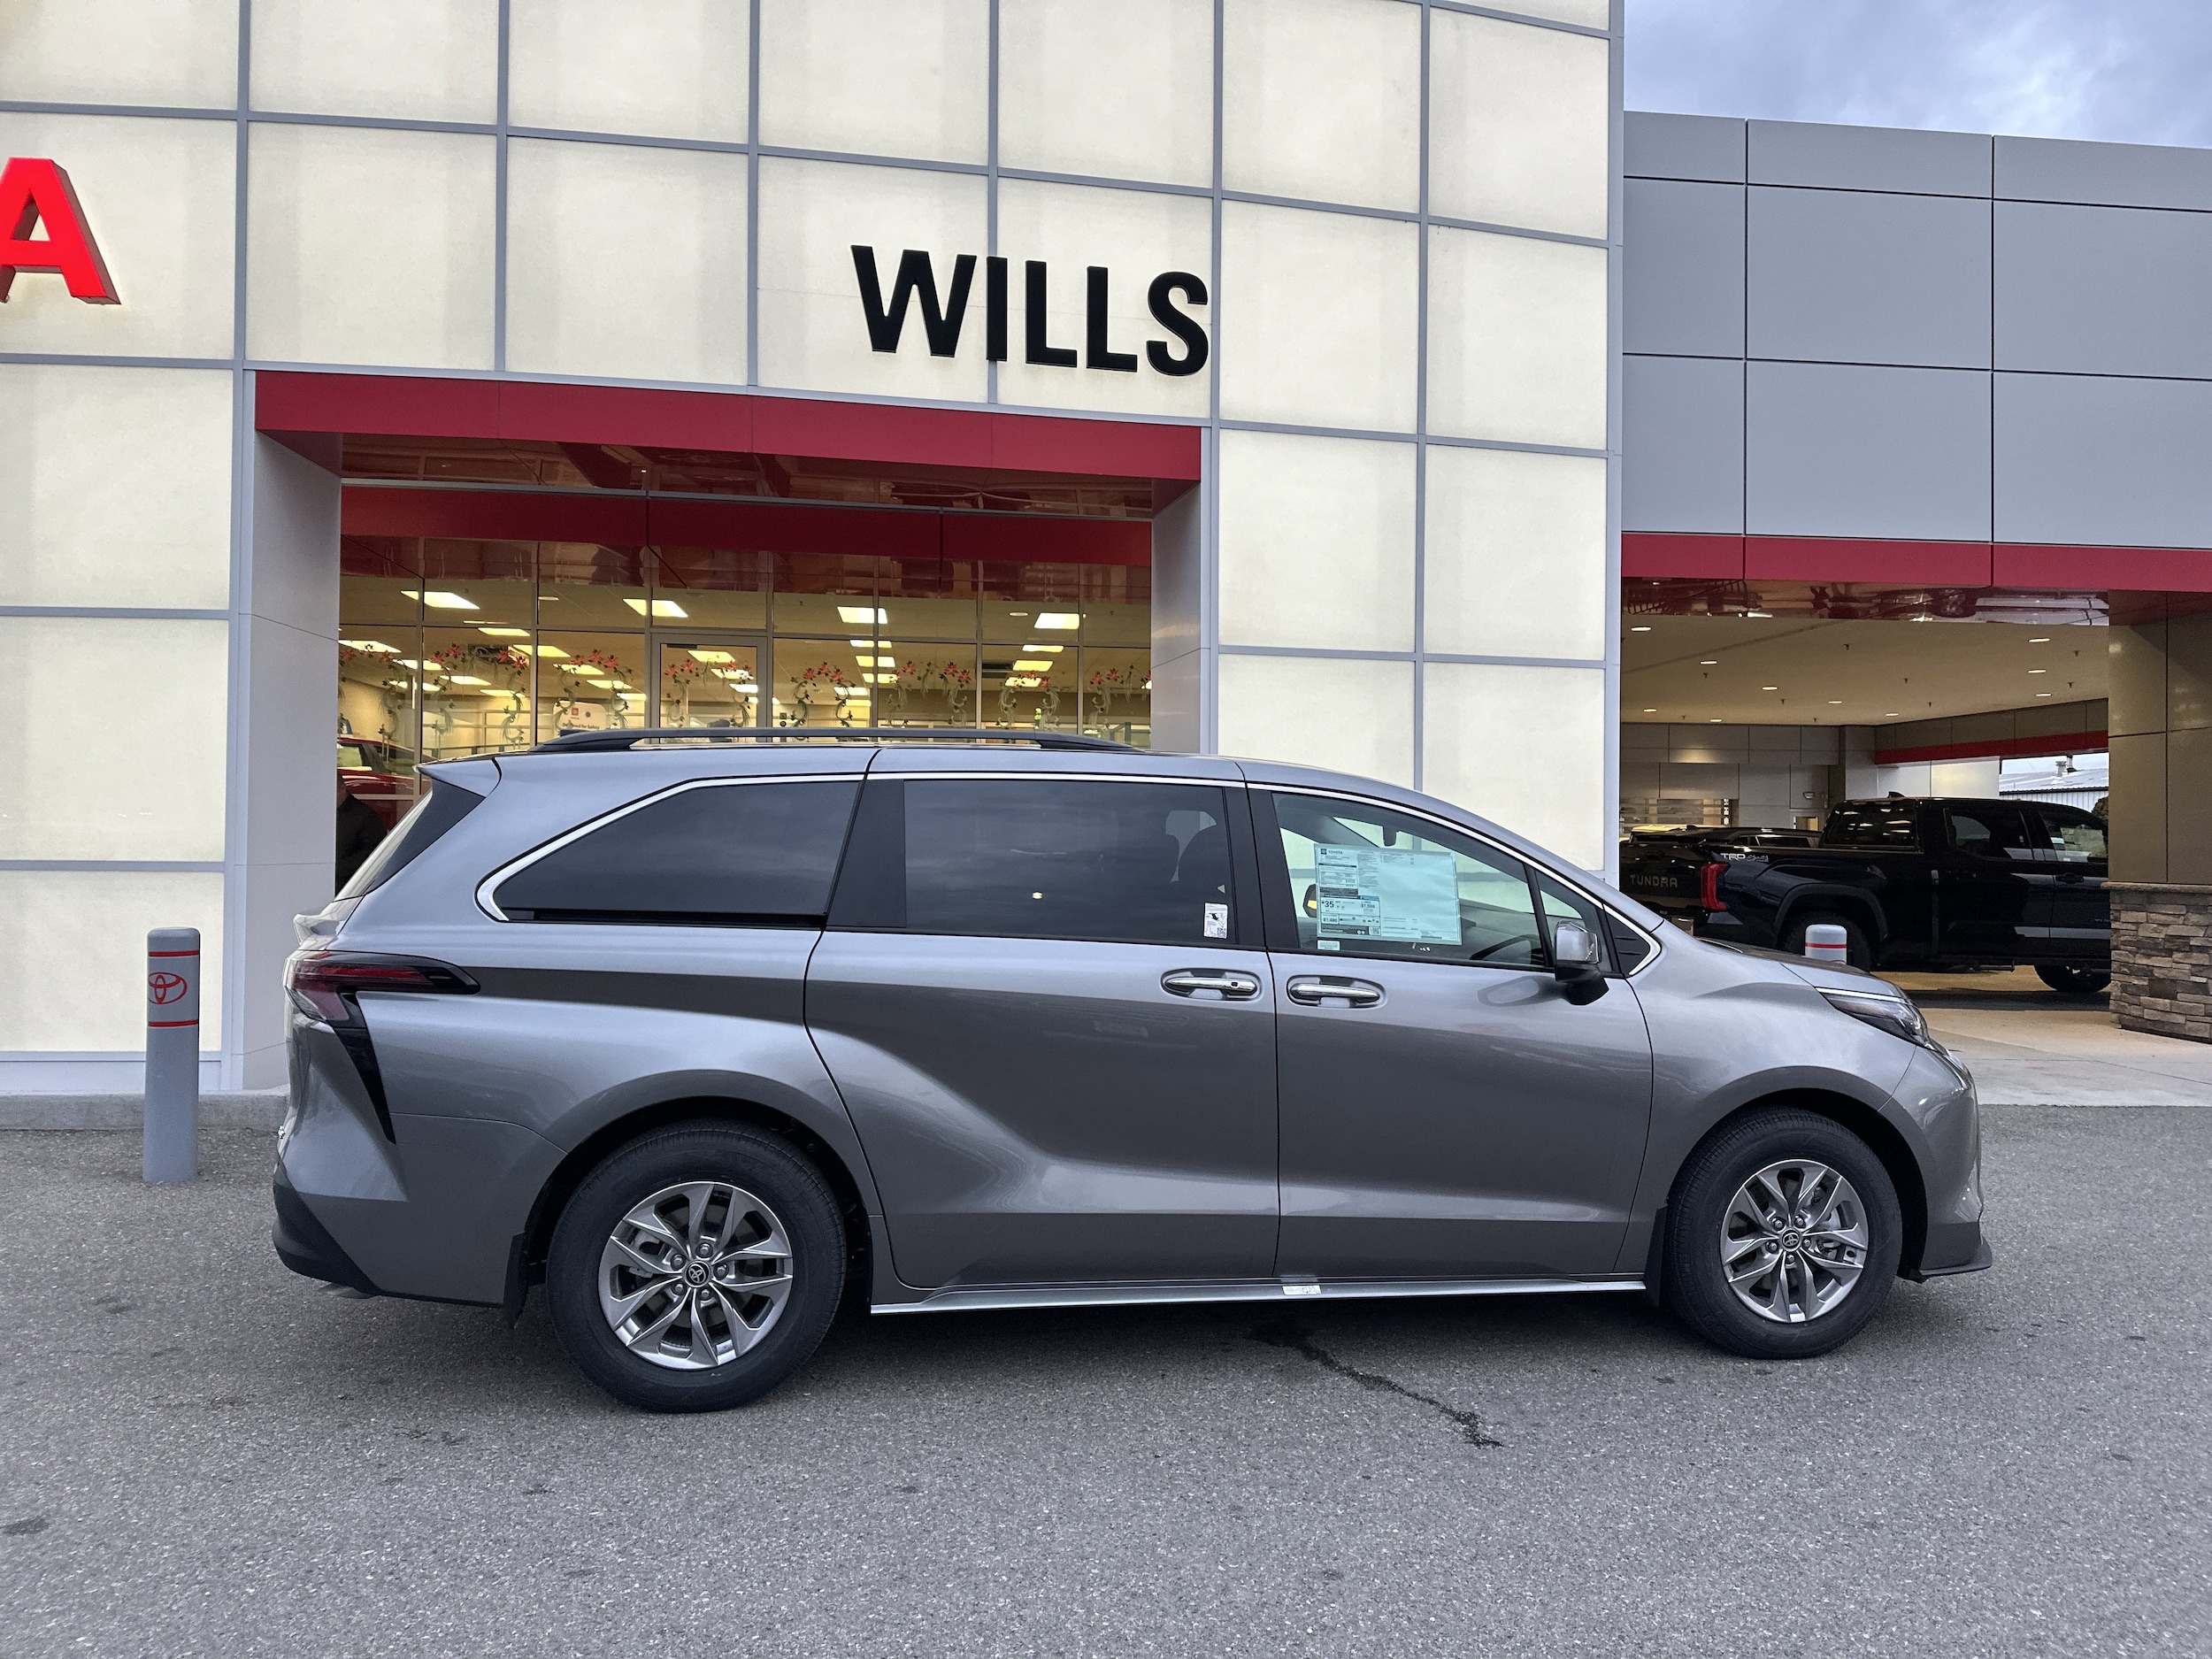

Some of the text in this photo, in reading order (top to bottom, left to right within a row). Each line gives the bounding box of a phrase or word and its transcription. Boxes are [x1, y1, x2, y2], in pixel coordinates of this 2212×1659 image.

[850, 243, 1210, 376] WILLS
[1630, 874, 1678, 888] TUNDRA
[1325, 900, 1334, 909] 35
